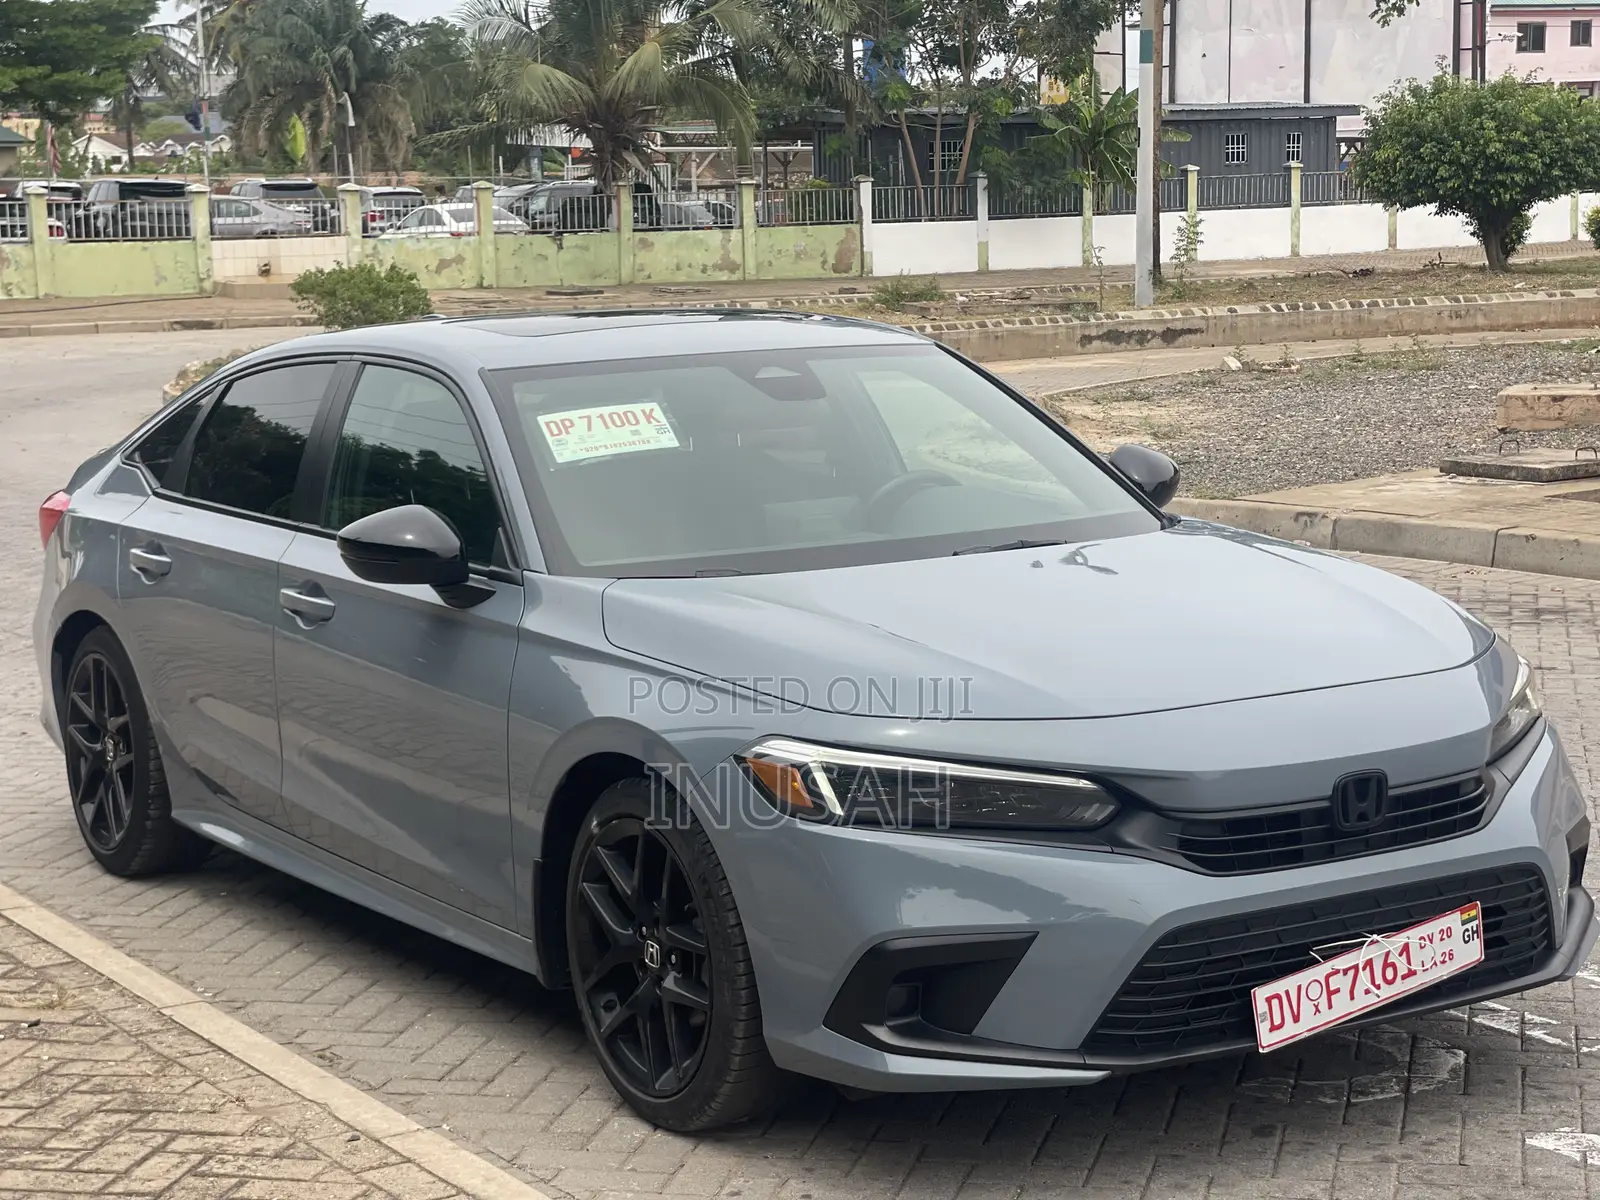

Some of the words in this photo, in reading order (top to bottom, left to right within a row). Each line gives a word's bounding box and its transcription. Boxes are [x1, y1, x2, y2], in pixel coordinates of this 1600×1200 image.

[544, 418, 575, 437] DP
[578, 410, 641, 433] 7100
[640, 408, 662, 424] K
[1439, 926, 1453, 942] 20
[1462, 924, 1479, 944] GH
[1439, 949, 1454, 964] 26
[1265, 984, 1302, 1033] DV
